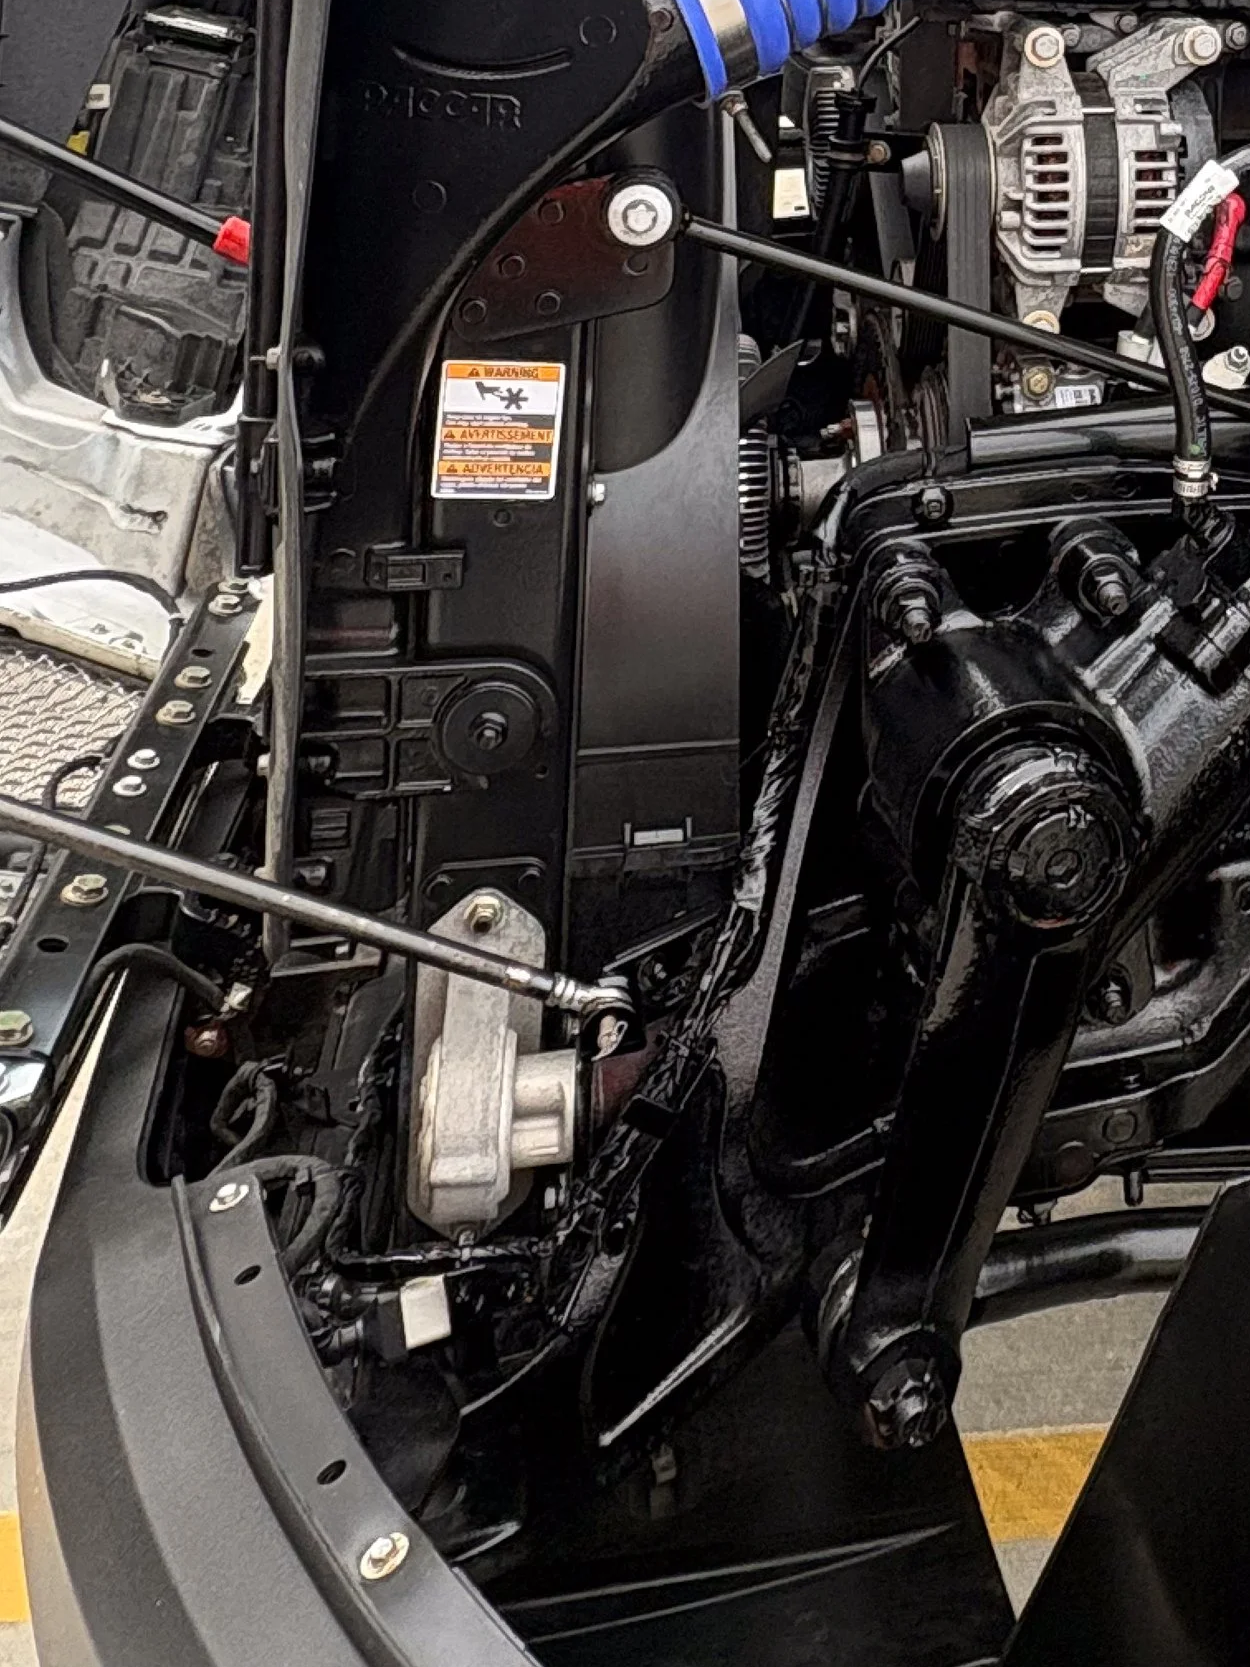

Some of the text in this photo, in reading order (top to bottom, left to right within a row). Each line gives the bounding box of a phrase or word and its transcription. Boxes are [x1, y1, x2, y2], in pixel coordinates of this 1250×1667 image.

[484, 367, 539, 379] WARNING
[460, 429, 551, 441] AVERTISSEMENT
[463, 464, 543, 475] ADVERTENCIA
